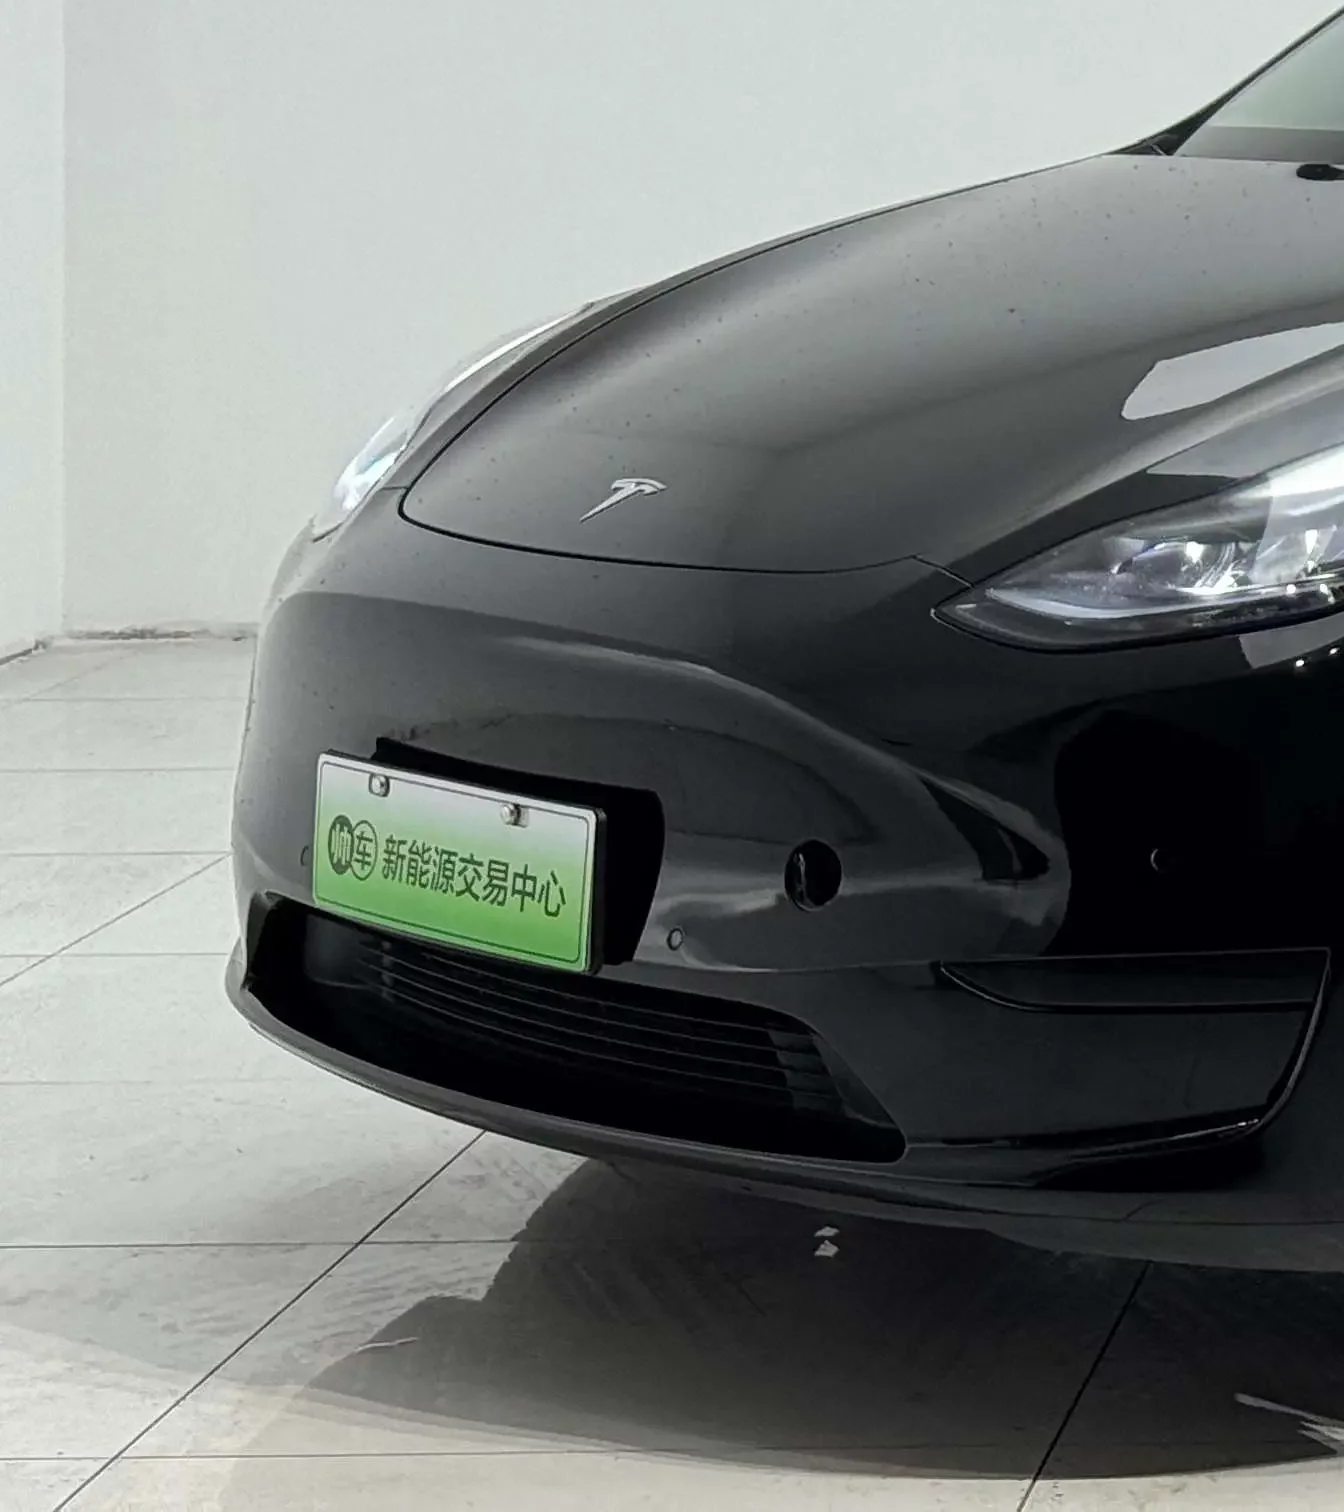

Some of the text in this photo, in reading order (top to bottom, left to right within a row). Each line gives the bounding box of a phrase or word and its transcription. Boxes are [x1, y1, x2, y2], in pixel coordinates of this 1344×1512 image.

[381, 834, 567, 919] 新能源交易中心
